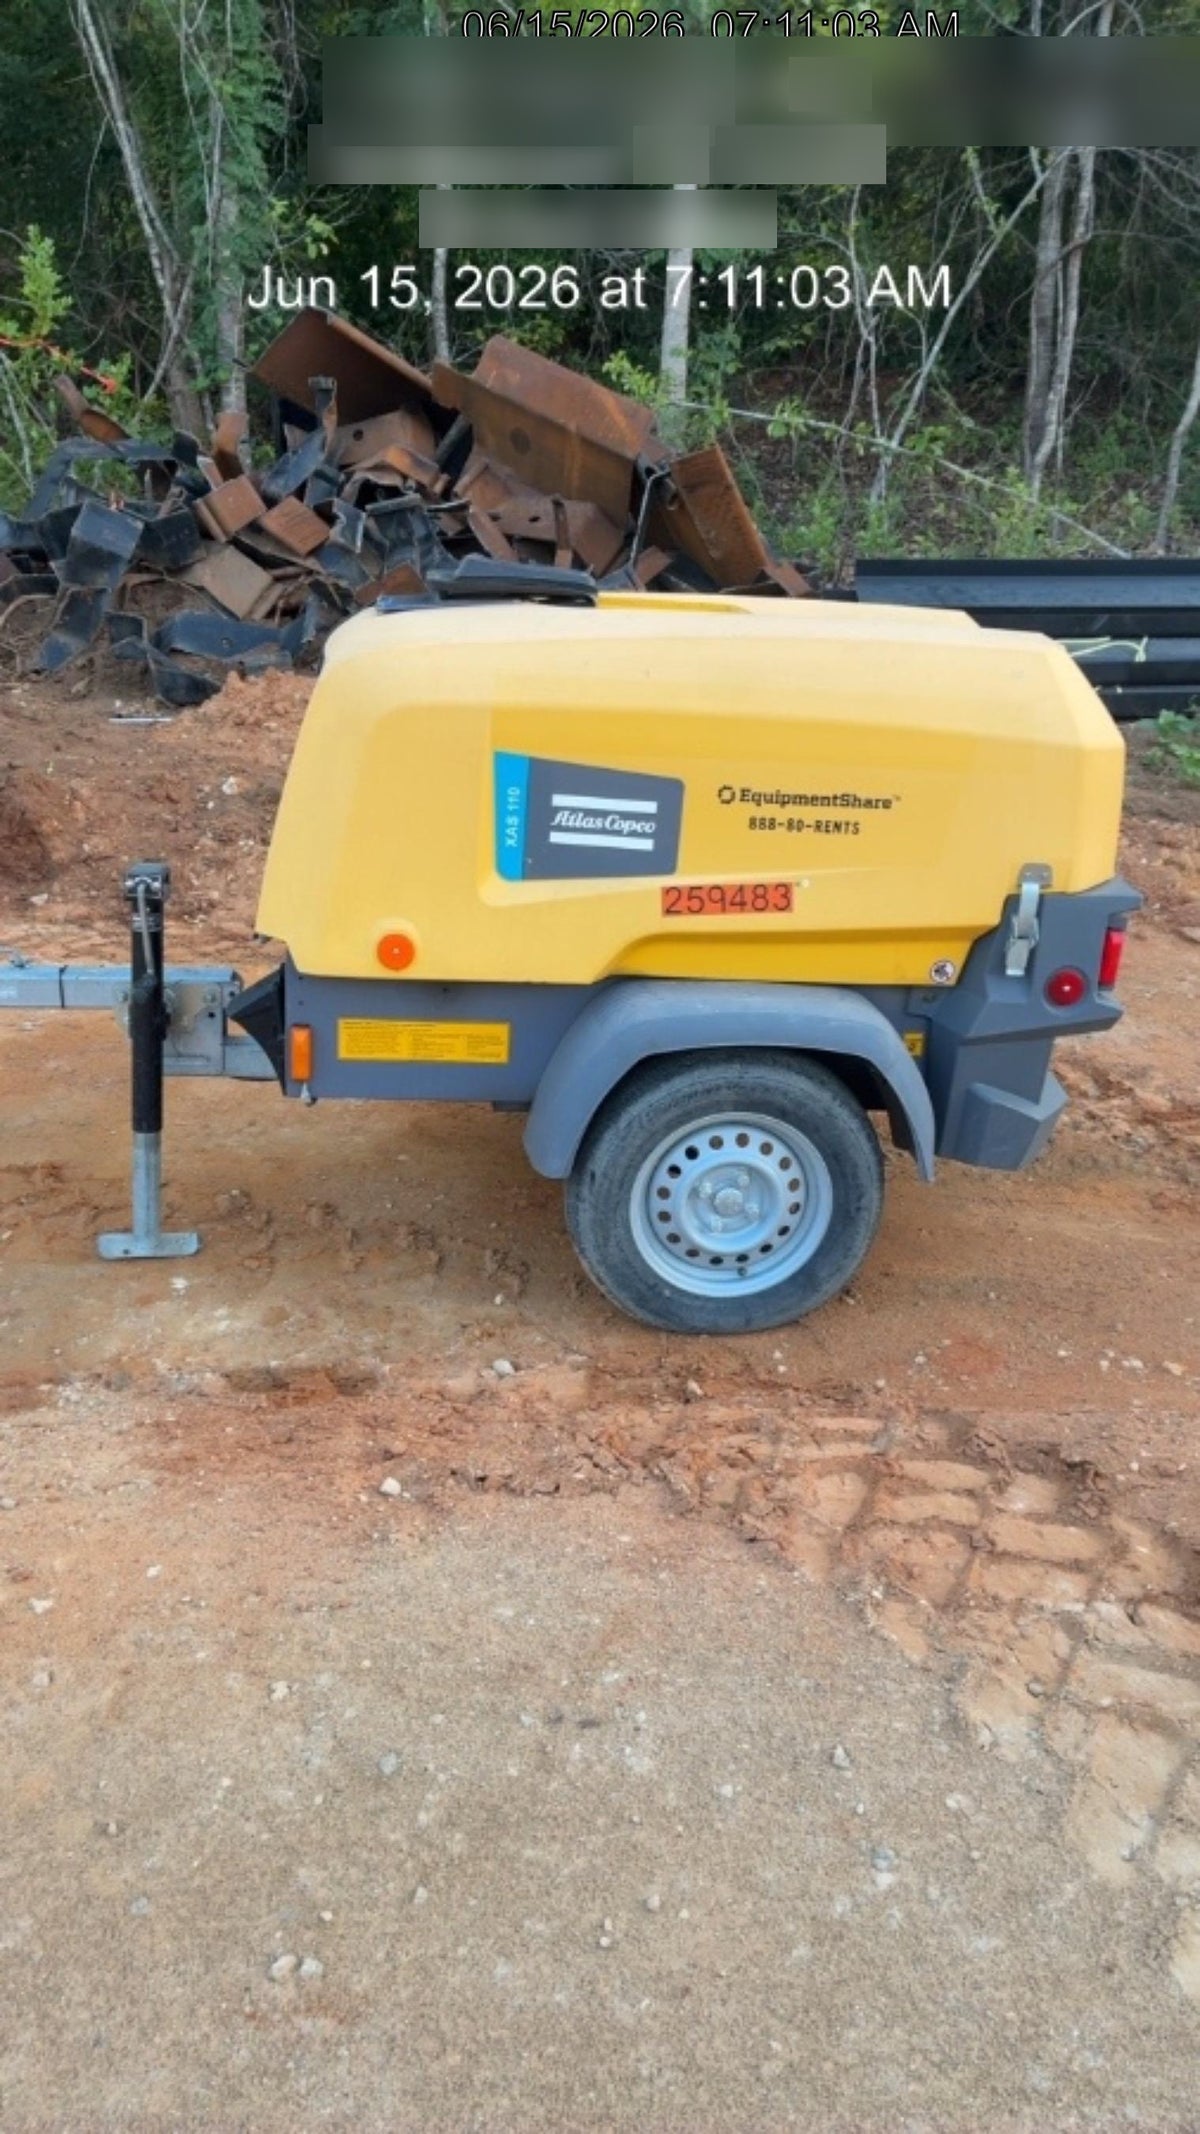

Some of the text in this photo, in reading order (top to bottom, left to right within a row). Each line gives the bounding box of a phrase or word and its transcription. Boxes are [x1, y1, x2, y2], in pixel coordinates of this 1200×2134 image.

[739, 787, 893, 809] EquipmentShare
[504, 786, 520, 847] XAS 110
[748, 816, 860, 835] 888-80-RENTS
[665, 883, 791, 914] 259483
